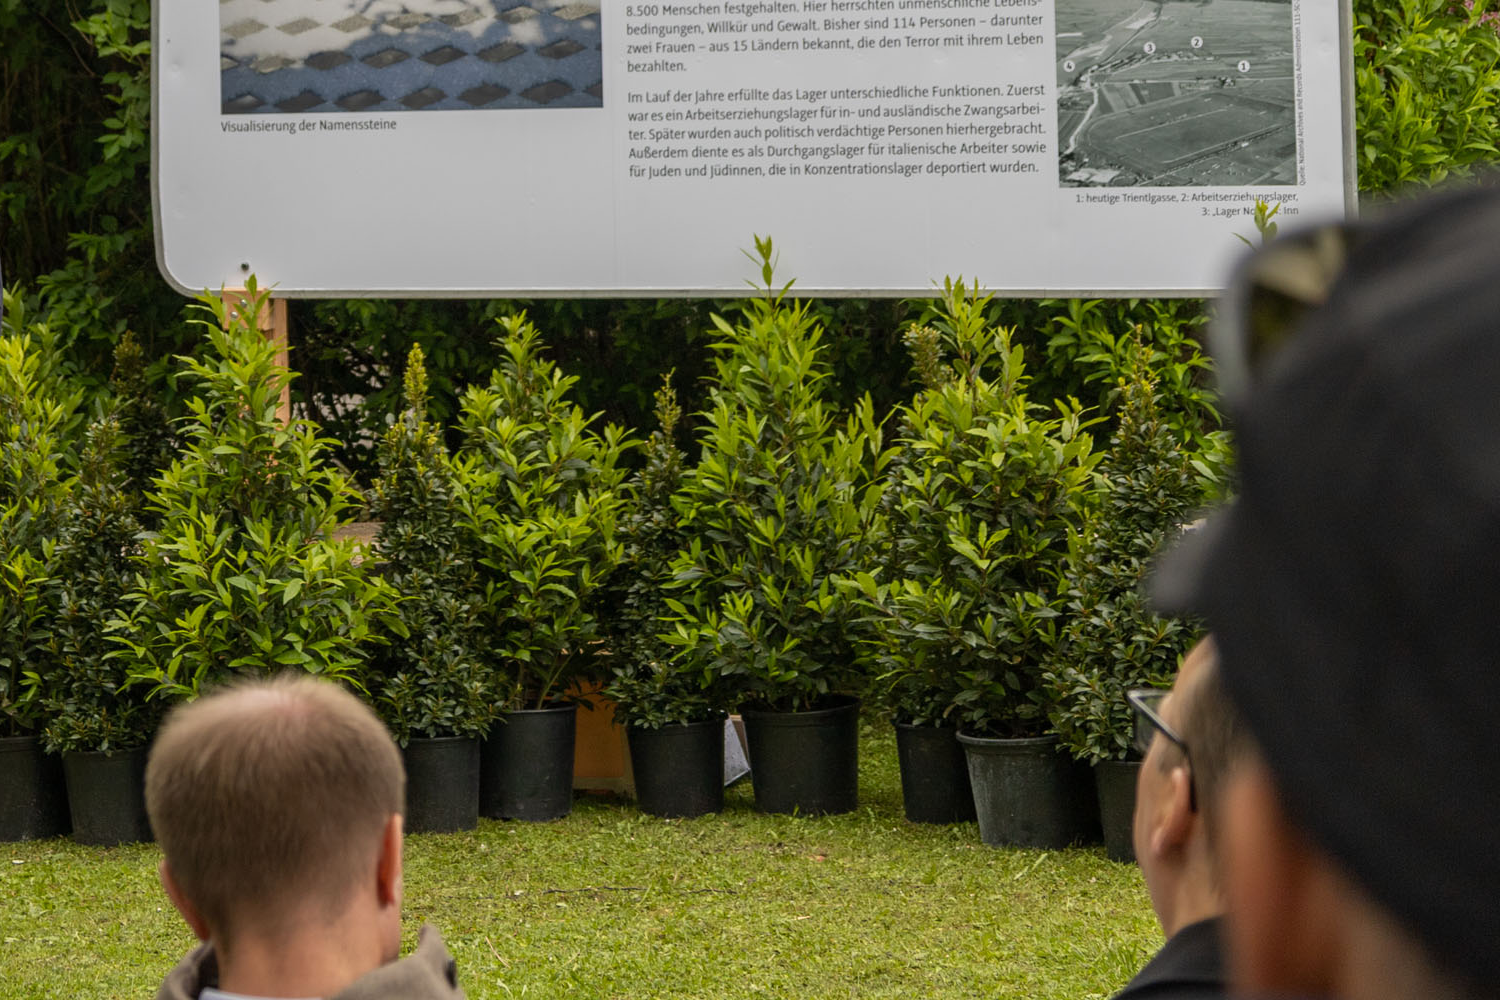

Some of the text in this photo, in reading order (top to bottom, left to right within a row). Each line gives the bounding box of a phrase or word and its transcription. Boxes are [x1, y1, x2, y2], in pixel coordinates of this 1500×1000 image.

[625, 4, 658, 16] 8.500
[661, 2, 720, 15] Menschen
[723, 0, 799, 17] festgehalten.
[803, 0, 827, 12] Hier
[626, 59, 686, 72] bezahlten.
[220, 118, 396, 134] Visualisierung der Namenssteine
[628, 121, 1046, 142] ter. Später wurden auch politisch verdächtige Personen hierhergebracht.
[628, 159, 1038, 179] für Juden und Jüdinnen, die in Konzentrationslager deportiert wurden.
[1284, 206, 1299, 215] Inn
